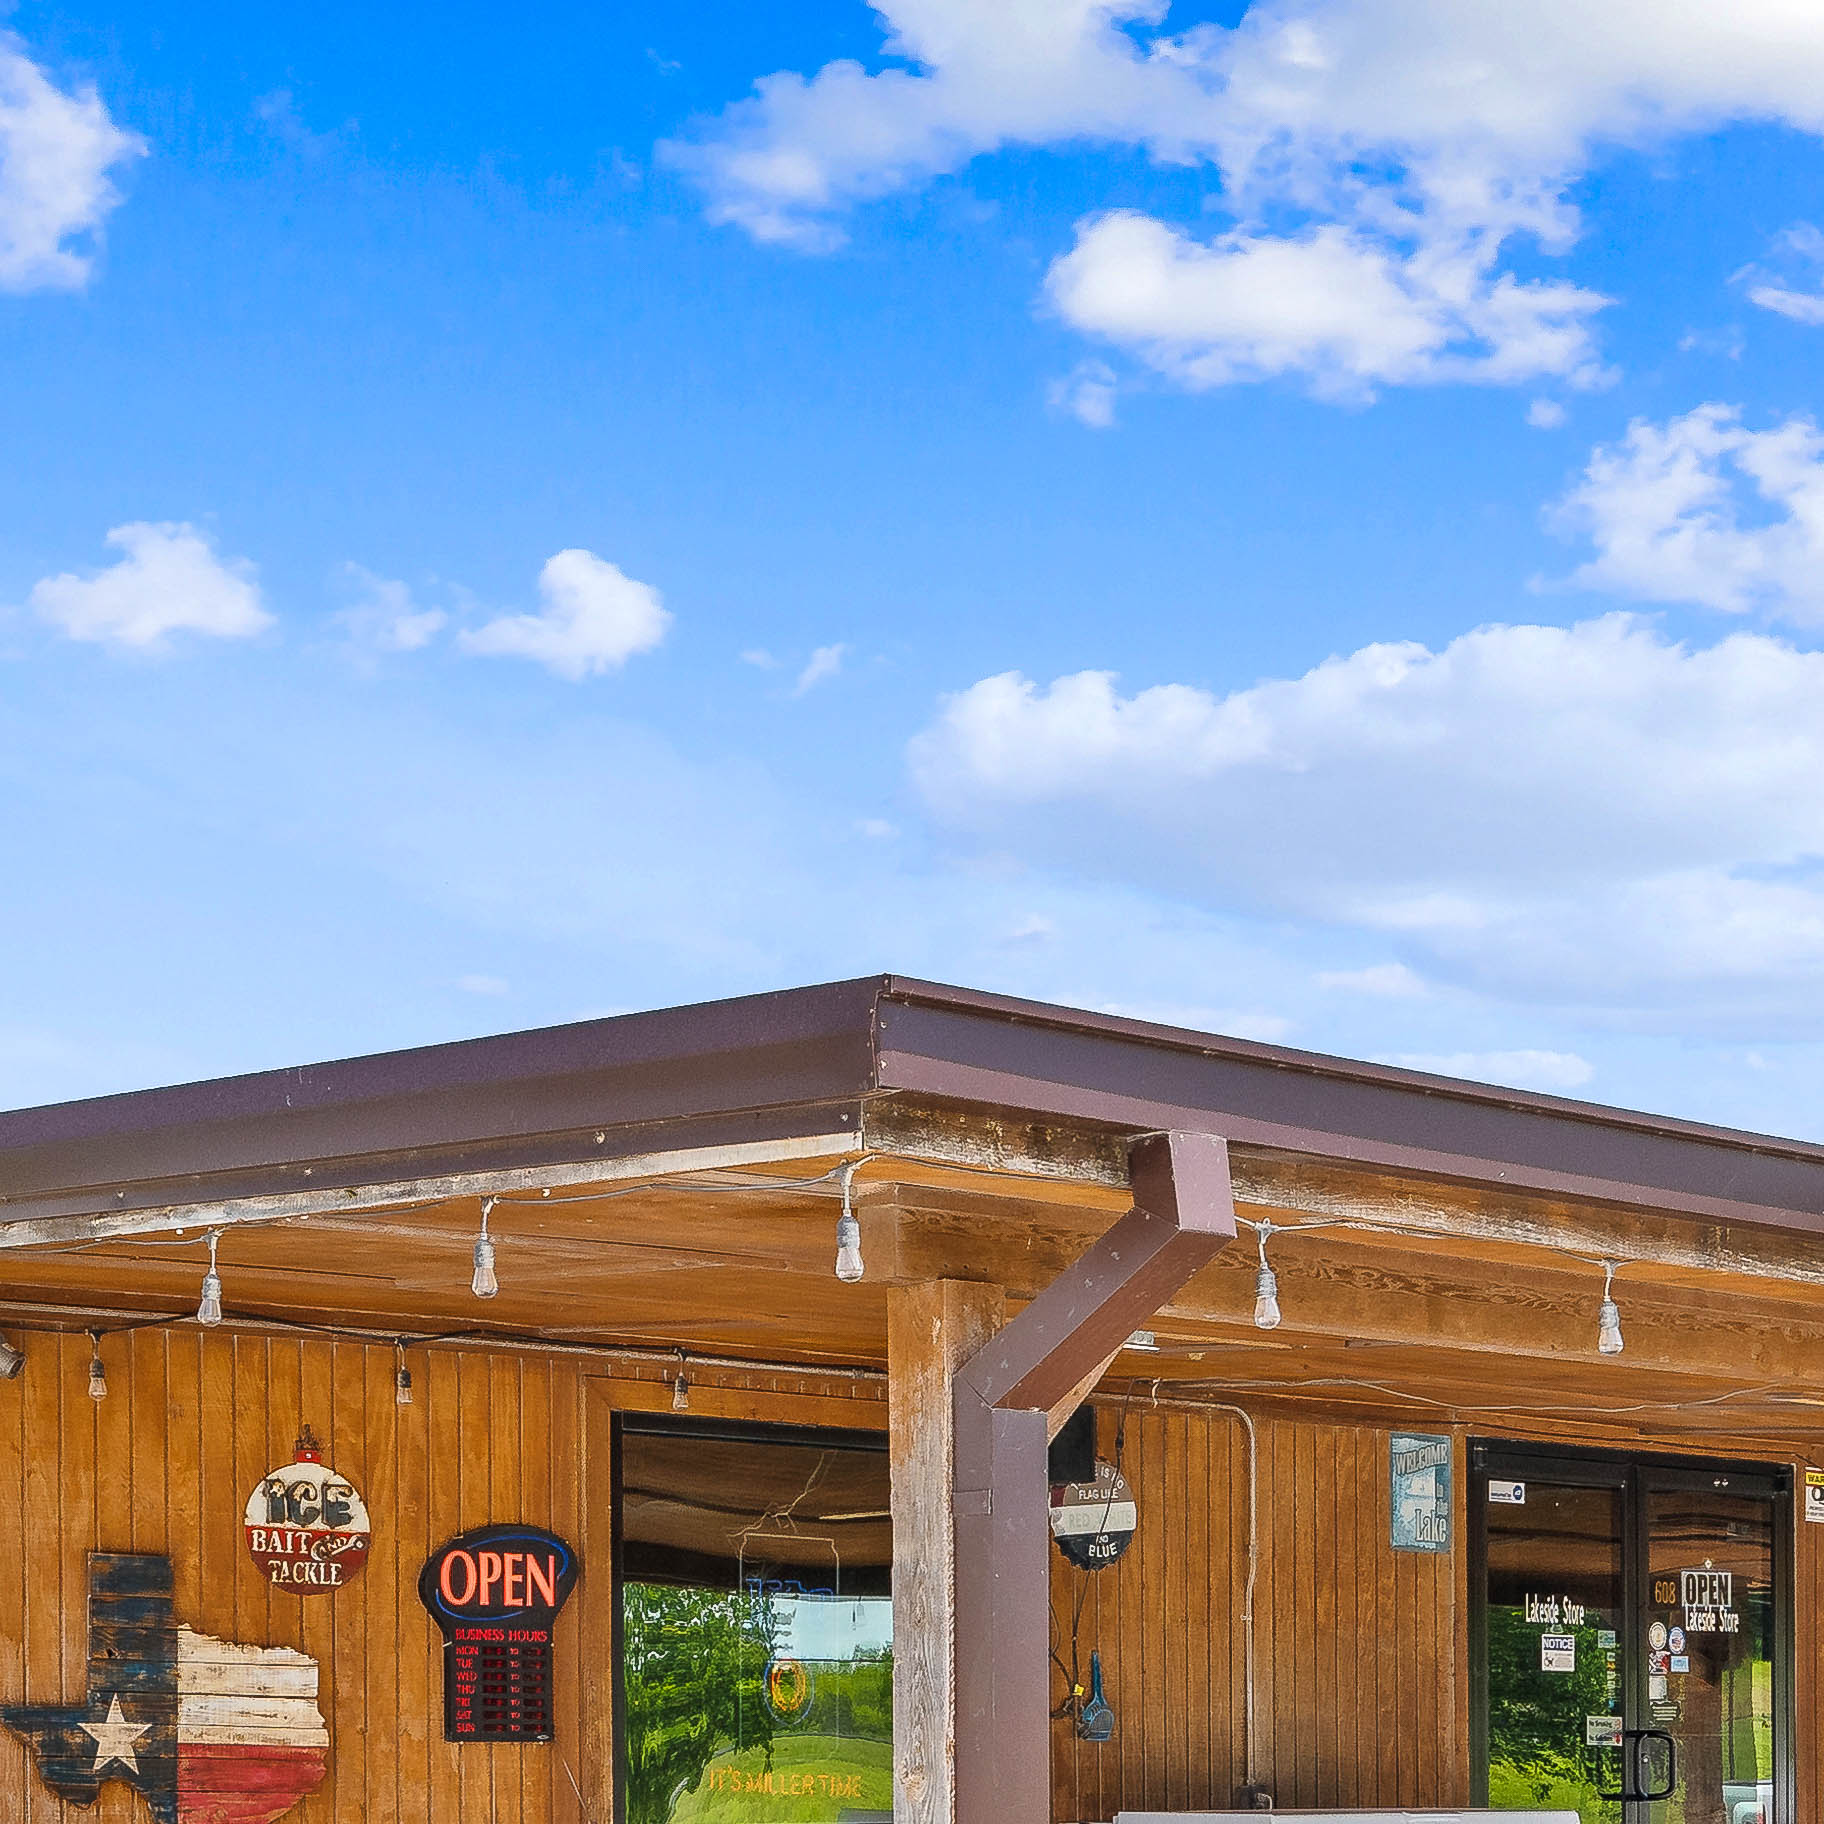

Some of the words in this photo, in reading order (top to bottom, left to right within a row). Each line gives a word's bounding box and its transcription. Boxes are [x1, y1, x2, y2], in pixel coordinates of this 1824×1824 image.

[1396, 1444, 1447, 1475] WELCOME
[262, 1478, 354, 1529] ICE
[1078, 1488, 1100, 1501] FLAG
[1100, 1487, 1120, 1499] LIE
[1415, 1507, 1447, 1543] Lake
[250, 1529, 313, 1555] BAIT
[1088, 1542, 1118, 1558] BLUE
[267, 1559, 344, 1586] TACKLE
[440, 1550, 556, 1608] OPEN
[1655, 1580, 1676, 1605] 608
[1685, 1573, 1729, 1606] OPEN
[1525, 1593, 1559, 1624] Lakeside
[1562, 1595, 1585, 1625] Store
[1685, 1605, 1716, 1632] Lakeside
[1719, 1605, 1740, 1633] Store
[455, 1628, 505, 1641] BUSINESS
[508, 1629, 549, 1643] HOURS
[1543, 1638, 1574, 1650] NOTICE
[456, 1646, 479, 1656] MON
[456, 1658, 473, 1669] TUE
[456, 1684, 476, 1695] THU
[456, 1710, 473, 1720] SAT
[456, 1723, 476, 1733] SUN
[709, 1764, 742, 1792] IT'S
[744, 1772, 815, 1796] MILLER
[816, 1774, 862, 1798] TIME
